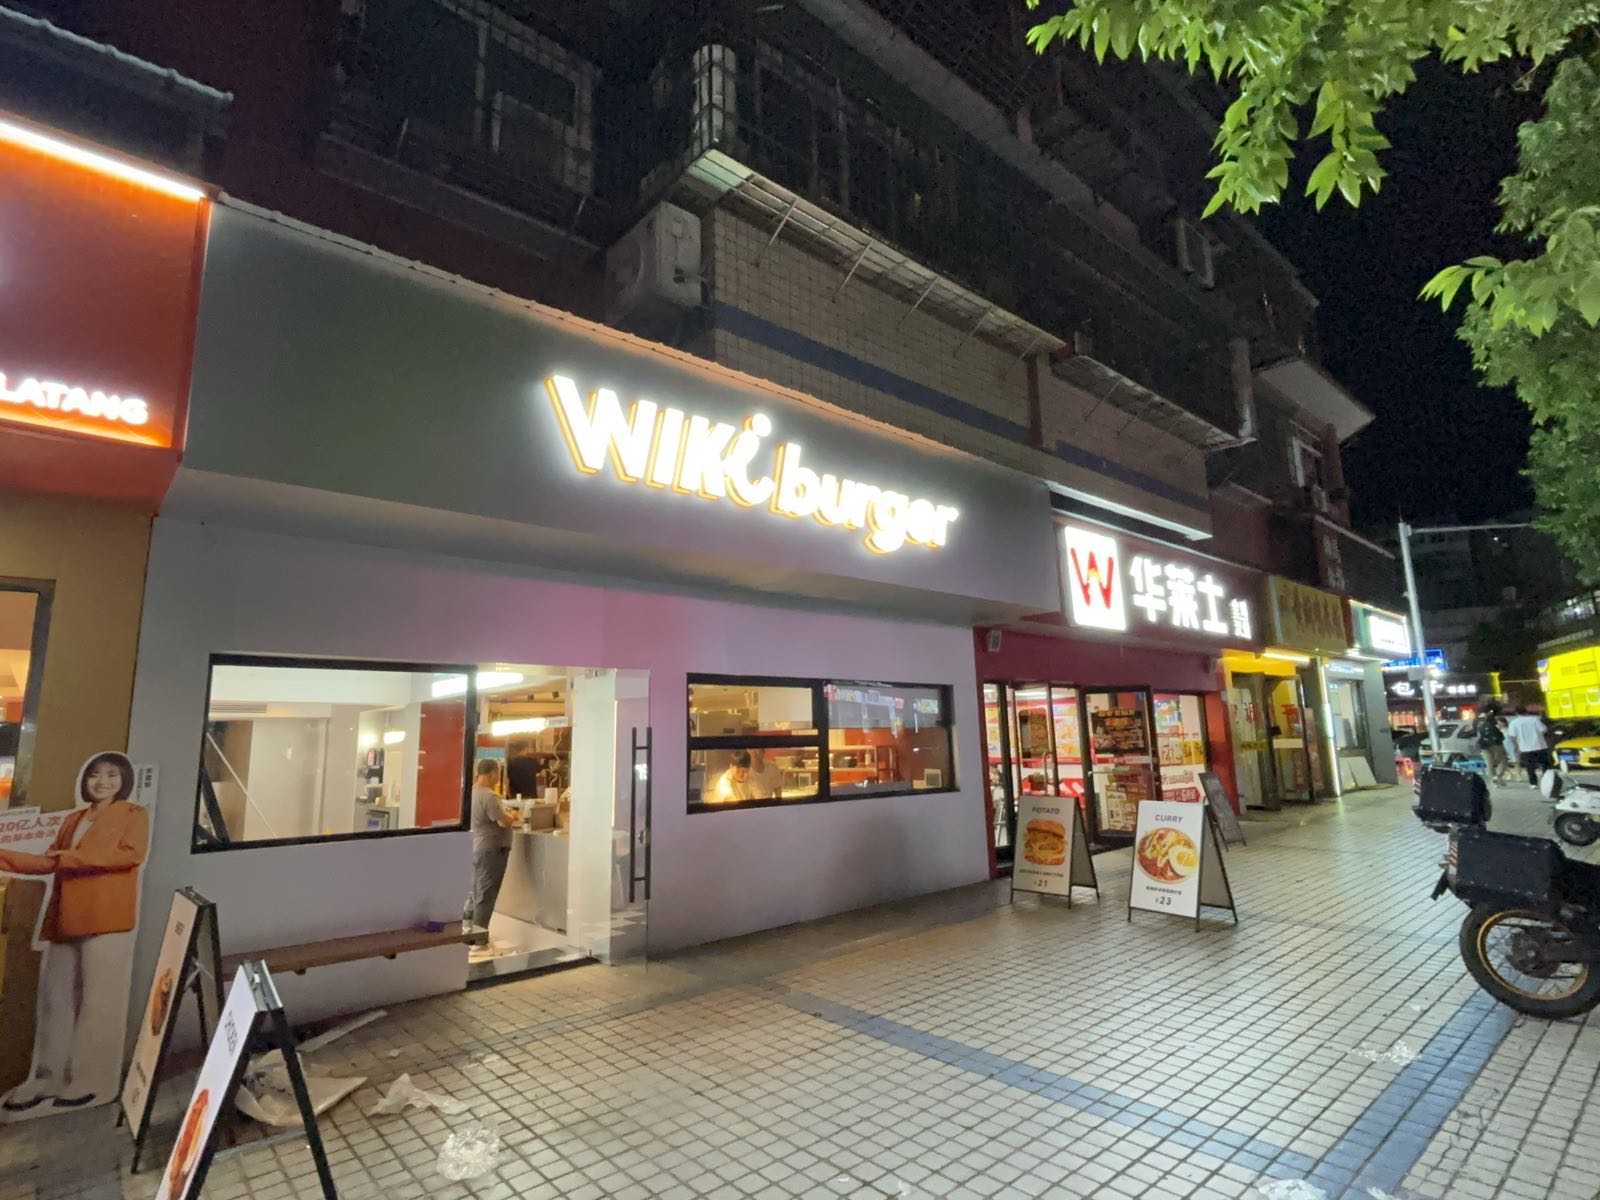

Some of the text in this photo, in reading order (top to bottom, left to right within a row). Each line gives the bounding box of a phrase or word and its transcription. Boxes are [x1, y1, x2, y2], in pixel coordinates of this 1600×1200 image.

[771, 442, 959, 554] burger
[1031, 806, 1061, 815] POTATO
[1155, 814, 1184, 823] CURRY
